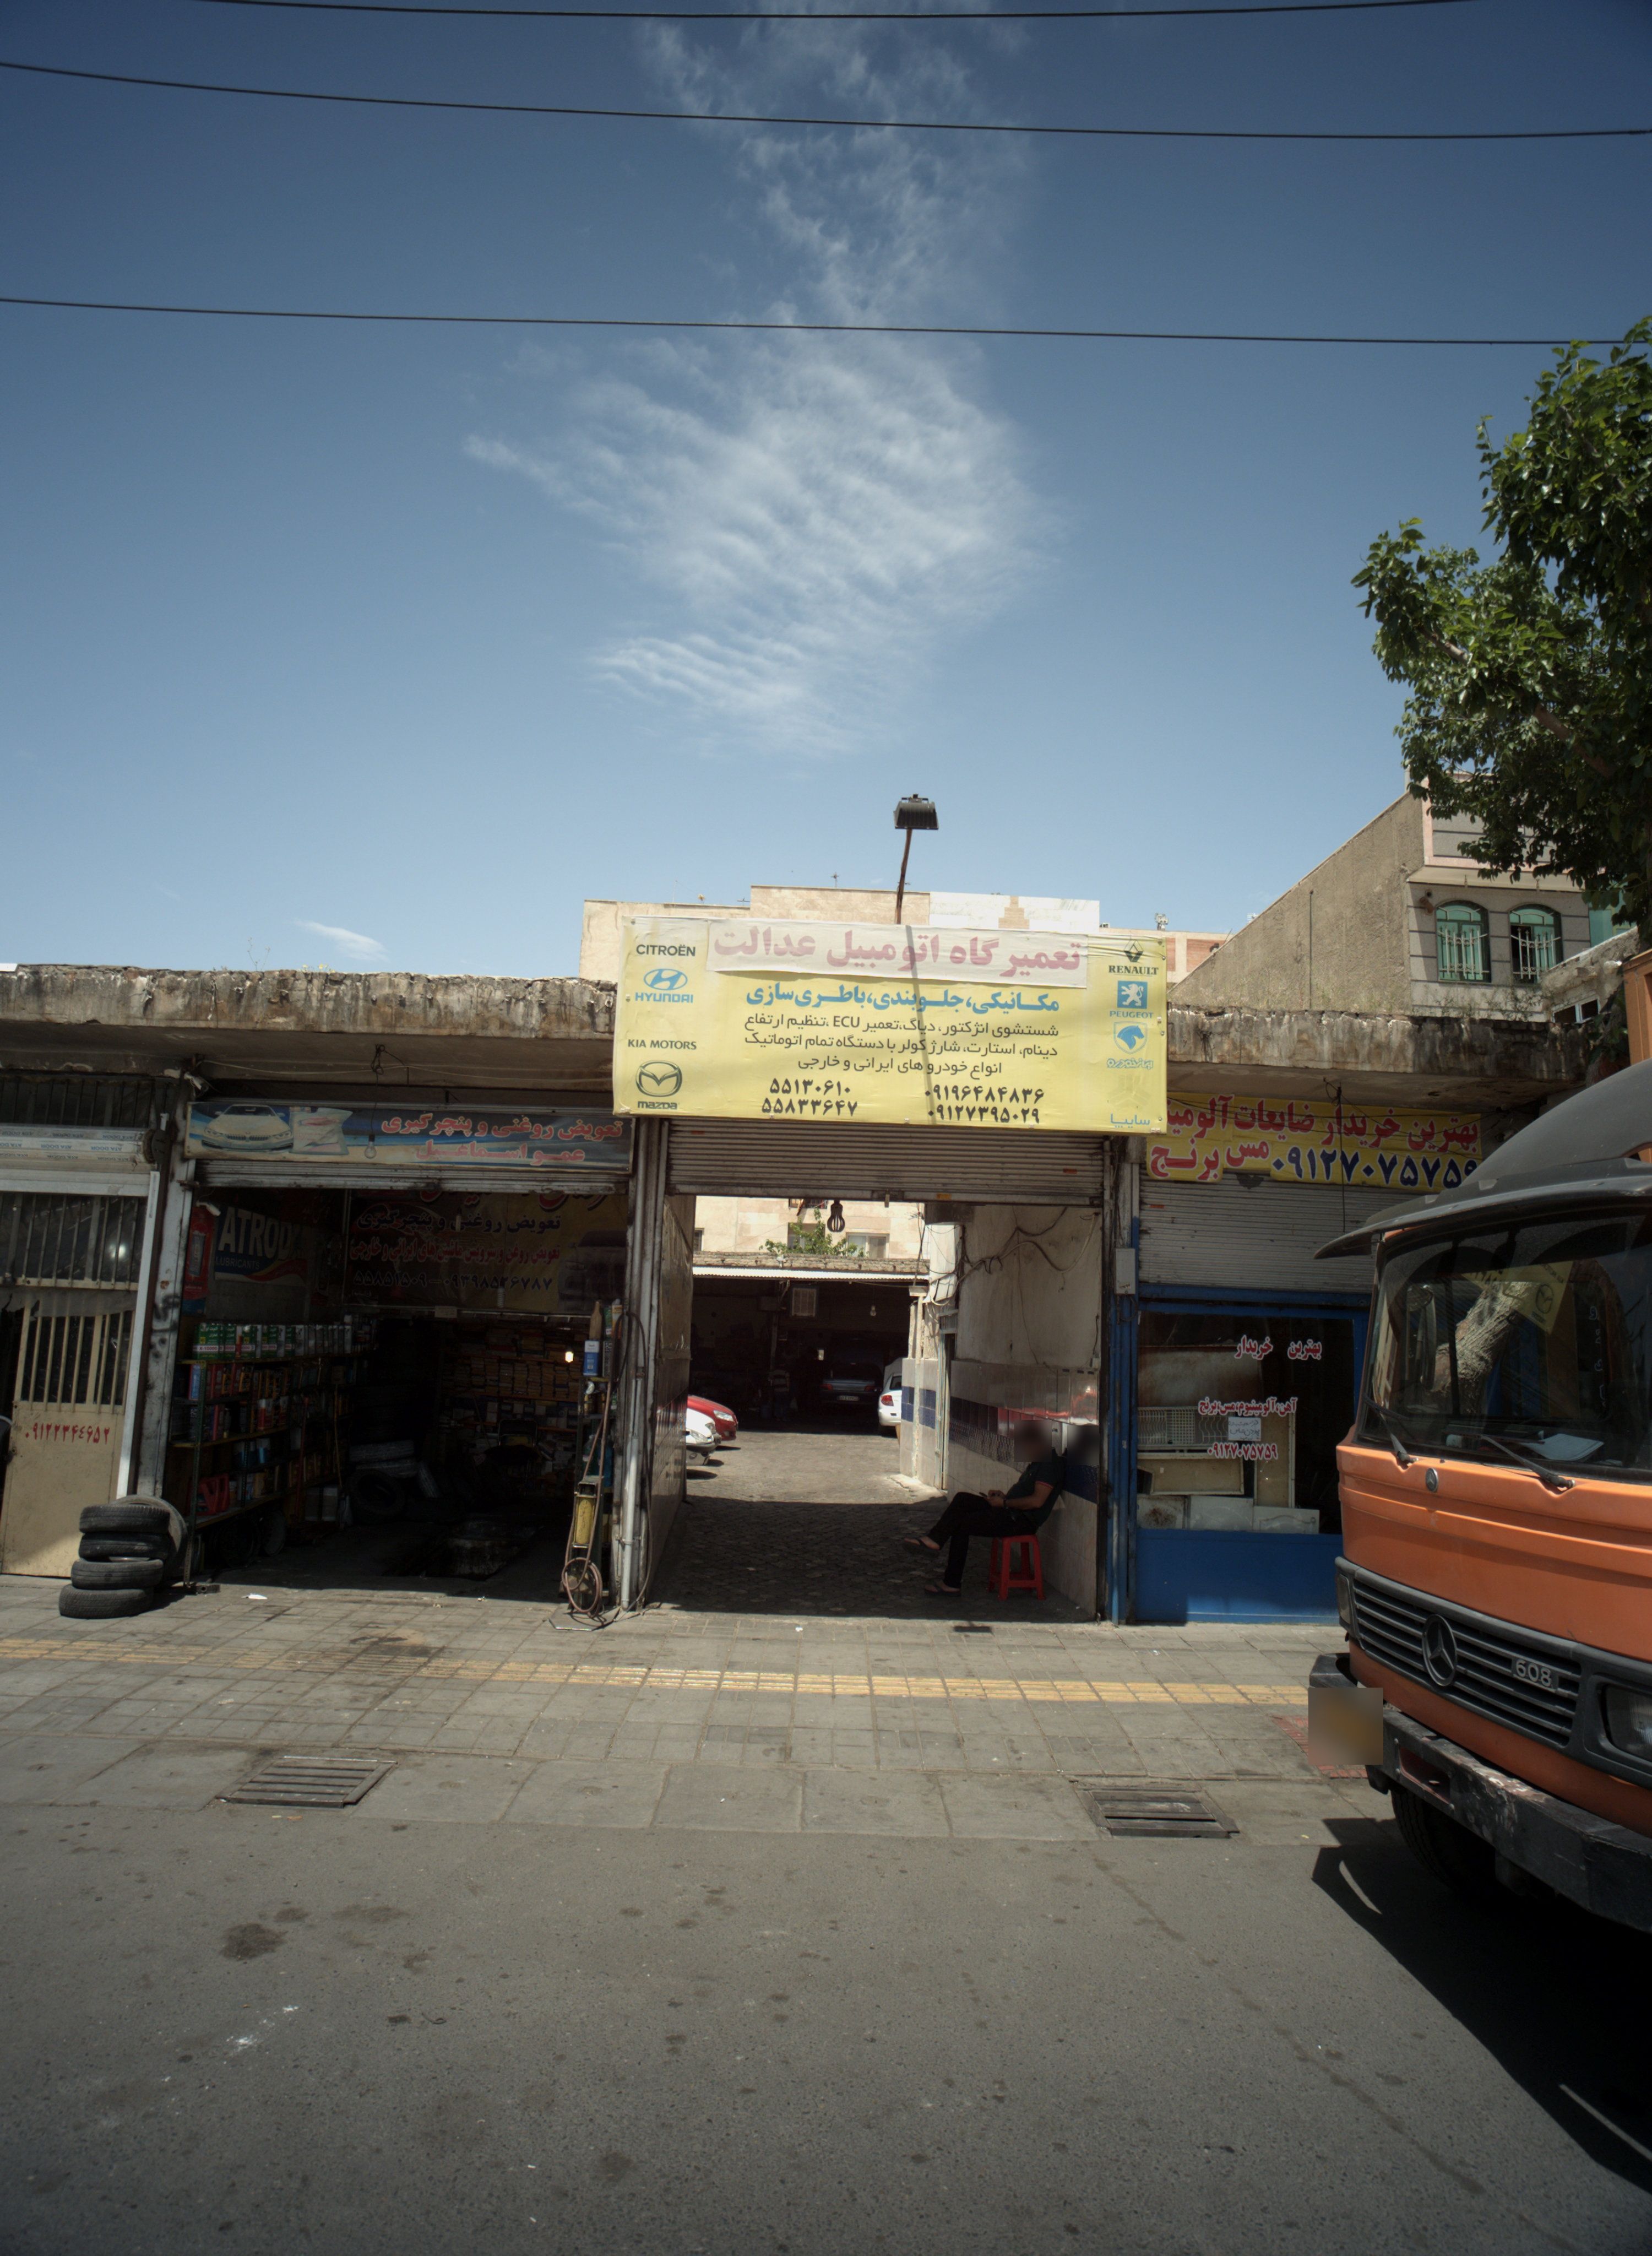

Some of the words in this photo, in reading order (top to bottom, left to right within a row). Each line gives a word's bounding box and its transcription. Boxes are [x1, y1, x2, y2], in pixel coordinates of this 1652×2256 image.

[636, 944, 696, 957] CITROËN
[714, 925, 816, 957] عدالت
[827, 930, 939, 972] اتومبیل
[1108, 965, 1159, 975] RENAULT
[635, 992, 694, 1004] HYUNDAI
[745, 1012, 784, 1031] ارتفاع
[833, 1016, 860, 1028] ECU
[1109, 1010, 1154, 1018] PEUGEOT
[992, 1023, 1059, 1038] شستشوی
[627, 1039, 646, 1048] KIA
[650, 1039, 697, 1050] MOTORS
[745, 1032, 802, 1049] اتوماتیک
[805, 1035, 833, 1050] تمام
[835, 1034, 884, 1049] دستگاه
[887, 1038, 896, 1054] با
[898, 1039, 926, 1054] کولر
[928, 1040, 960, 1055] شارژ
[798, 1055, 840, 1070] خارجی
[843, 1060, 851, 1071] و
[854, 1057, 893, 1073] ایرانی
[970, 1061, 1002, 1080] انواع
[769, 1077, 851, 1096] ۵۵۱۳۰۶۱۰
[925, 1084, 1045, 1104] ۰۹۱۹۶۴۸۴۸۳۶
[761, 1097, 858, 1116] ۵۵۸۳۳۶۴۷
[927, 1104, 1040, 1124] ۰۹۱۲۷۳۹۵۰۲۹
[475, 1121, 488, 1136] و
[492, 1117, 555, 1140] روغنی
[1110, 1113, 1151, 1128] سایپا
[1234, 1098, 1315, 1141] ضایعات
[1321, 1105, 1401, 1149] خریدار
[558, 1119, 623, 1141] تعویض
[1408, 1116, 1478, 1153] بهترین
[416, 1138, 528, 1160] اسماعیل
[530, 1148, 585, 1166] عمو
[1225, 1141, 1269, 1167] مس
[1150, 1138, 1220, 1181] برنج
[506, 1215, 561, 1234] تعویض
[215, 1256, 260, 1270] LUBRICANTS
[1234, 1335, 1274, 1360] خریدار
[1287, 1338, 1322, 1360] بهترین
[1207, 1442, 1278, 1461] ۰۹۱۲۷۰۷۵۷۵۹
[1515, 1659, 1552, 1687] 608
